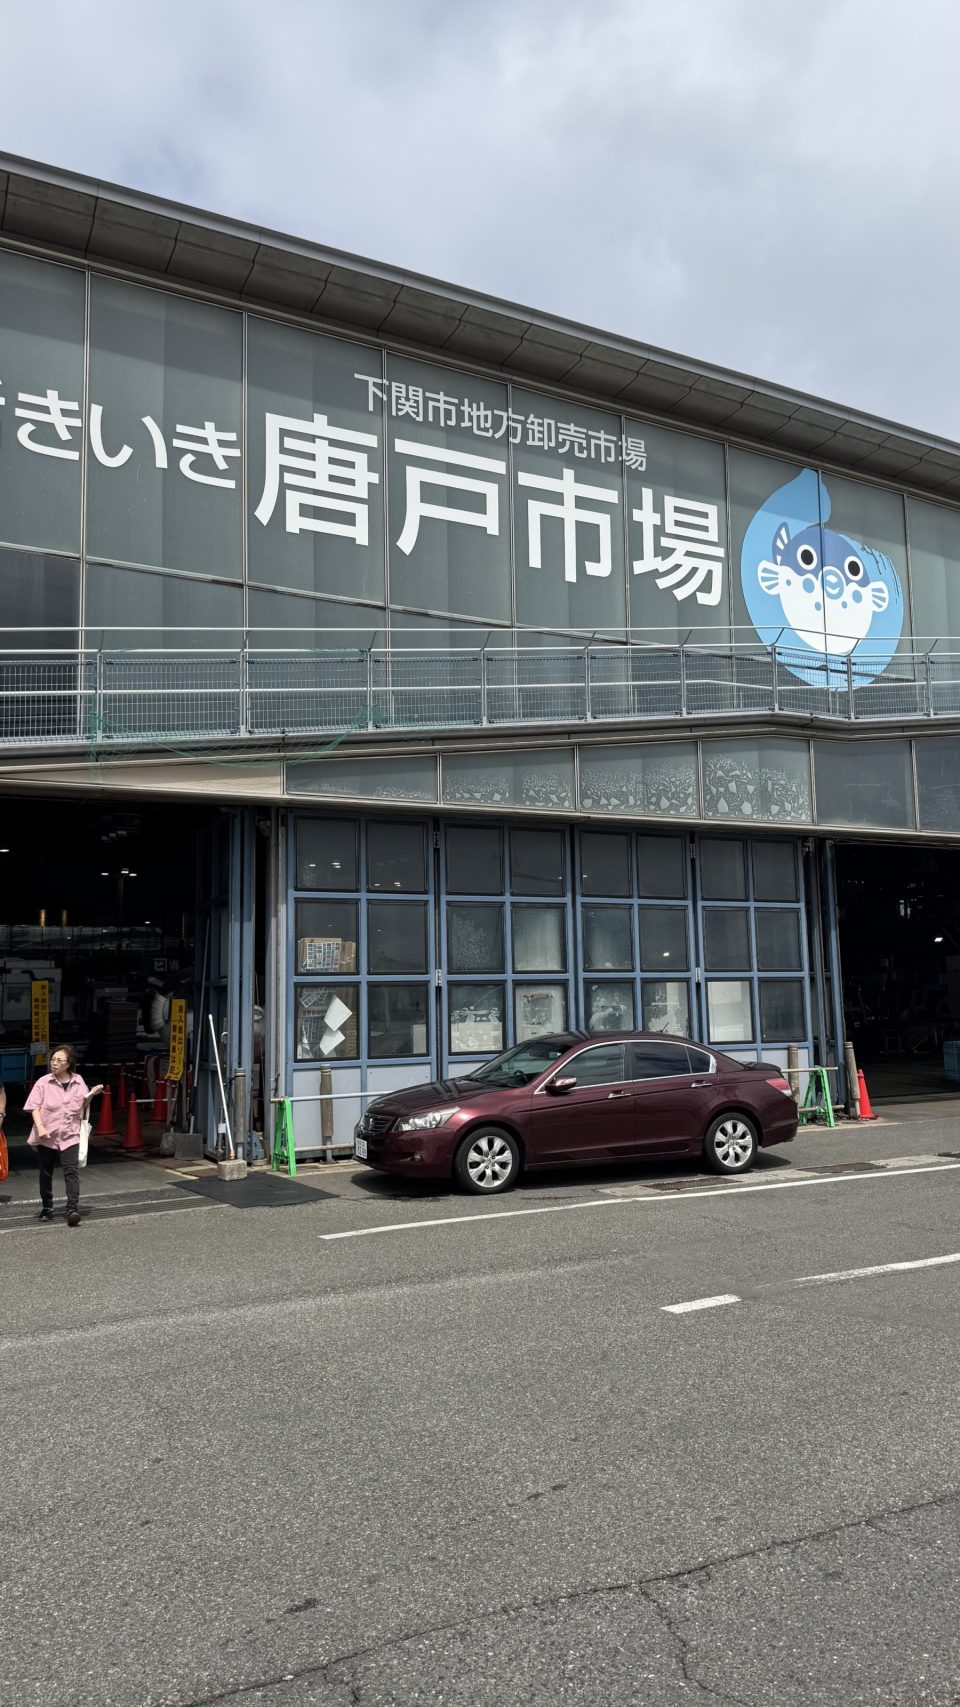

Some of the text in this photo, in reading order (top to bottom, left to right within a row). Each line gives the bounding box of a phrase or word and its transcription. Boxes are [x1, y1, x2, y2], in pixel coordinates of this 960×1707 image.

[0, 378, 241, 489] きいき
[354, 373, 647, 472] 下関市地方卸売市場
[254, 412, 725, 607] 唐戸市場
